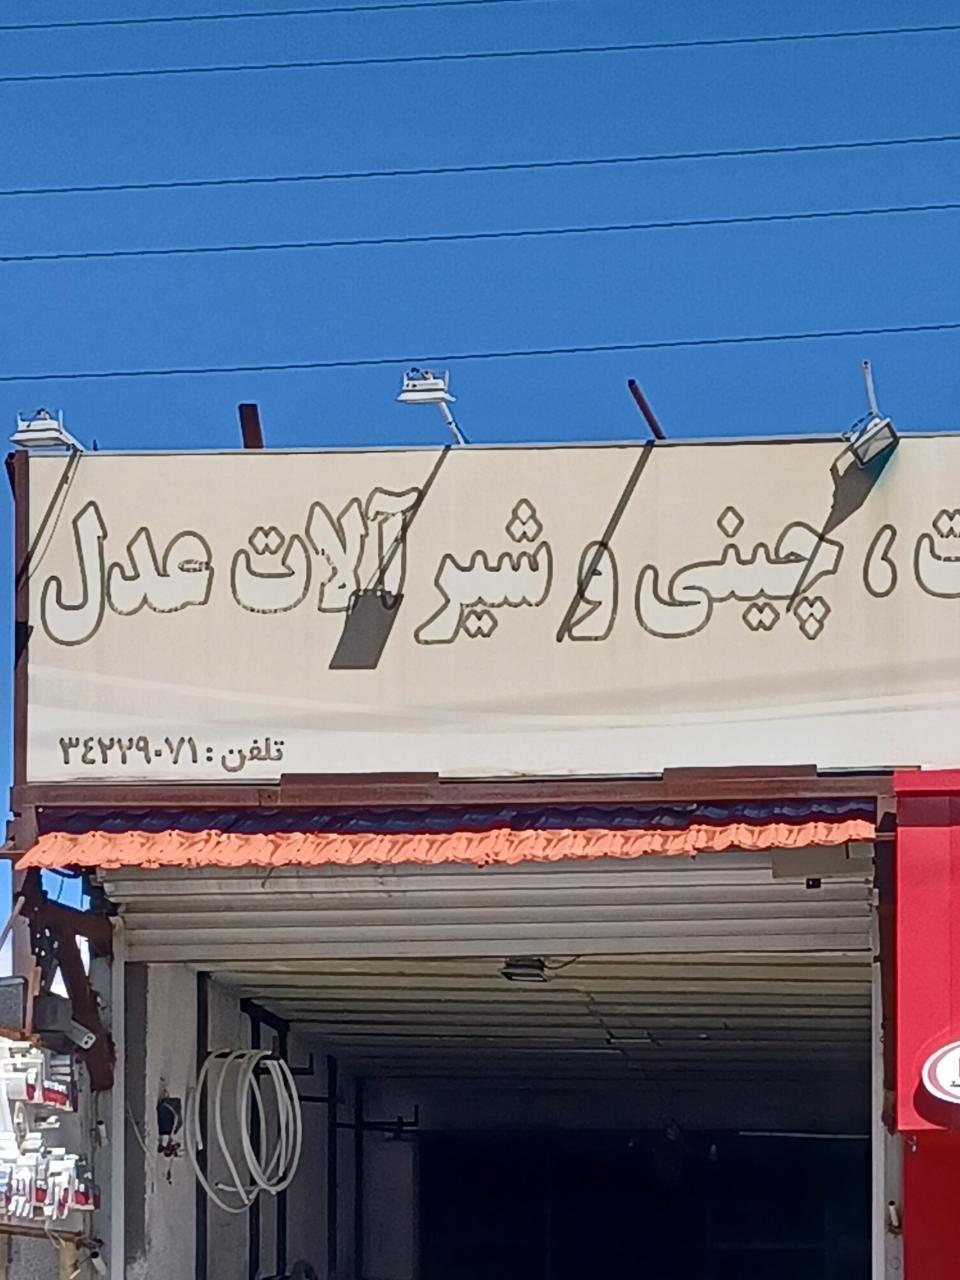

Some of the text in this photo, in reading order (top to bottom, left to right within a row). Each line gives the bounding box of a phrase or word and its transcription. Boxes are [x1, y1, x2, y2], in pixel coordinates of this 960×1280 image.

[40, 500, 216, 646] عدل
[563, 541, 620, 642] و
[635, 506, 844, 640] چینی
